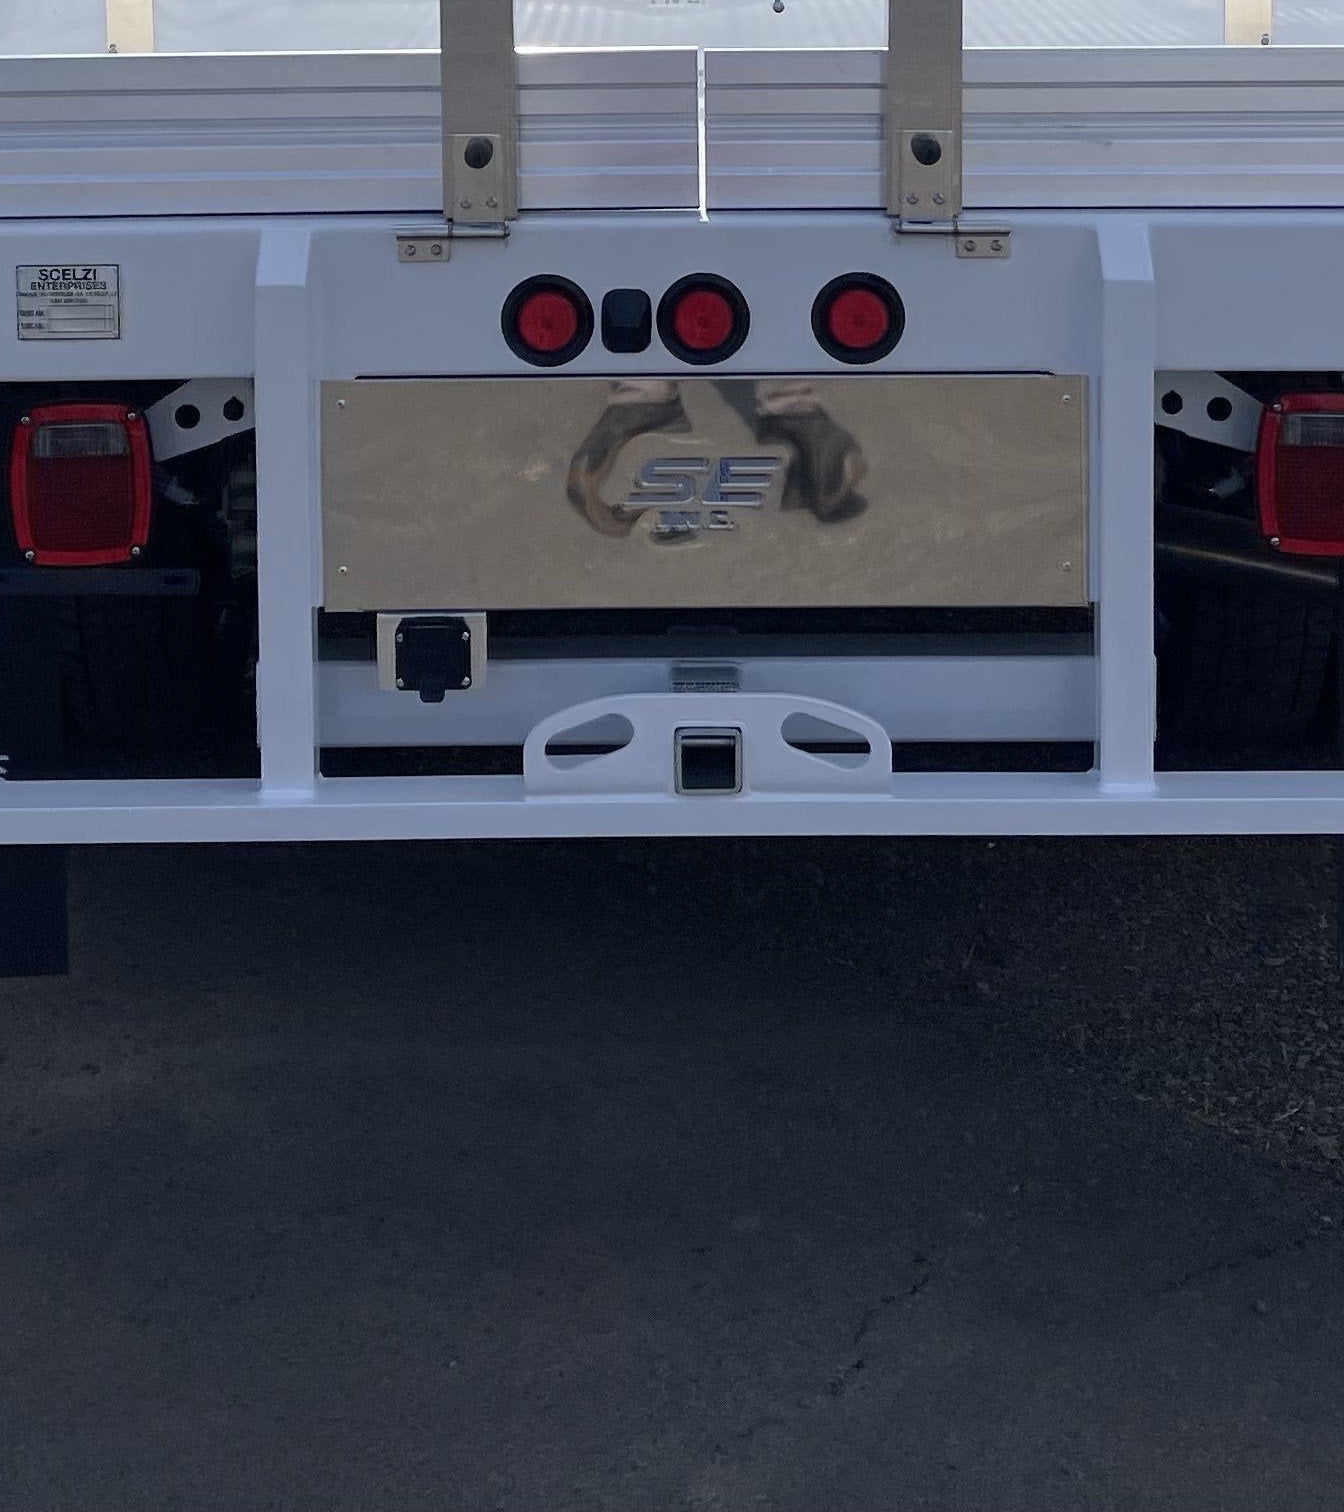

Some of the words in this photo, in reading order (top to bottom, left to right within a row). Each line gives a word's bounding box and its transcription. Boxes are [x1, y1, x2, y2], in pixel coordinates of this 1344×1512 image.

[37, 268, 97, 281] SCELZI
[30, 281, 107, 290] ENTERPRISES
[624, 456, 782, 506] SE
